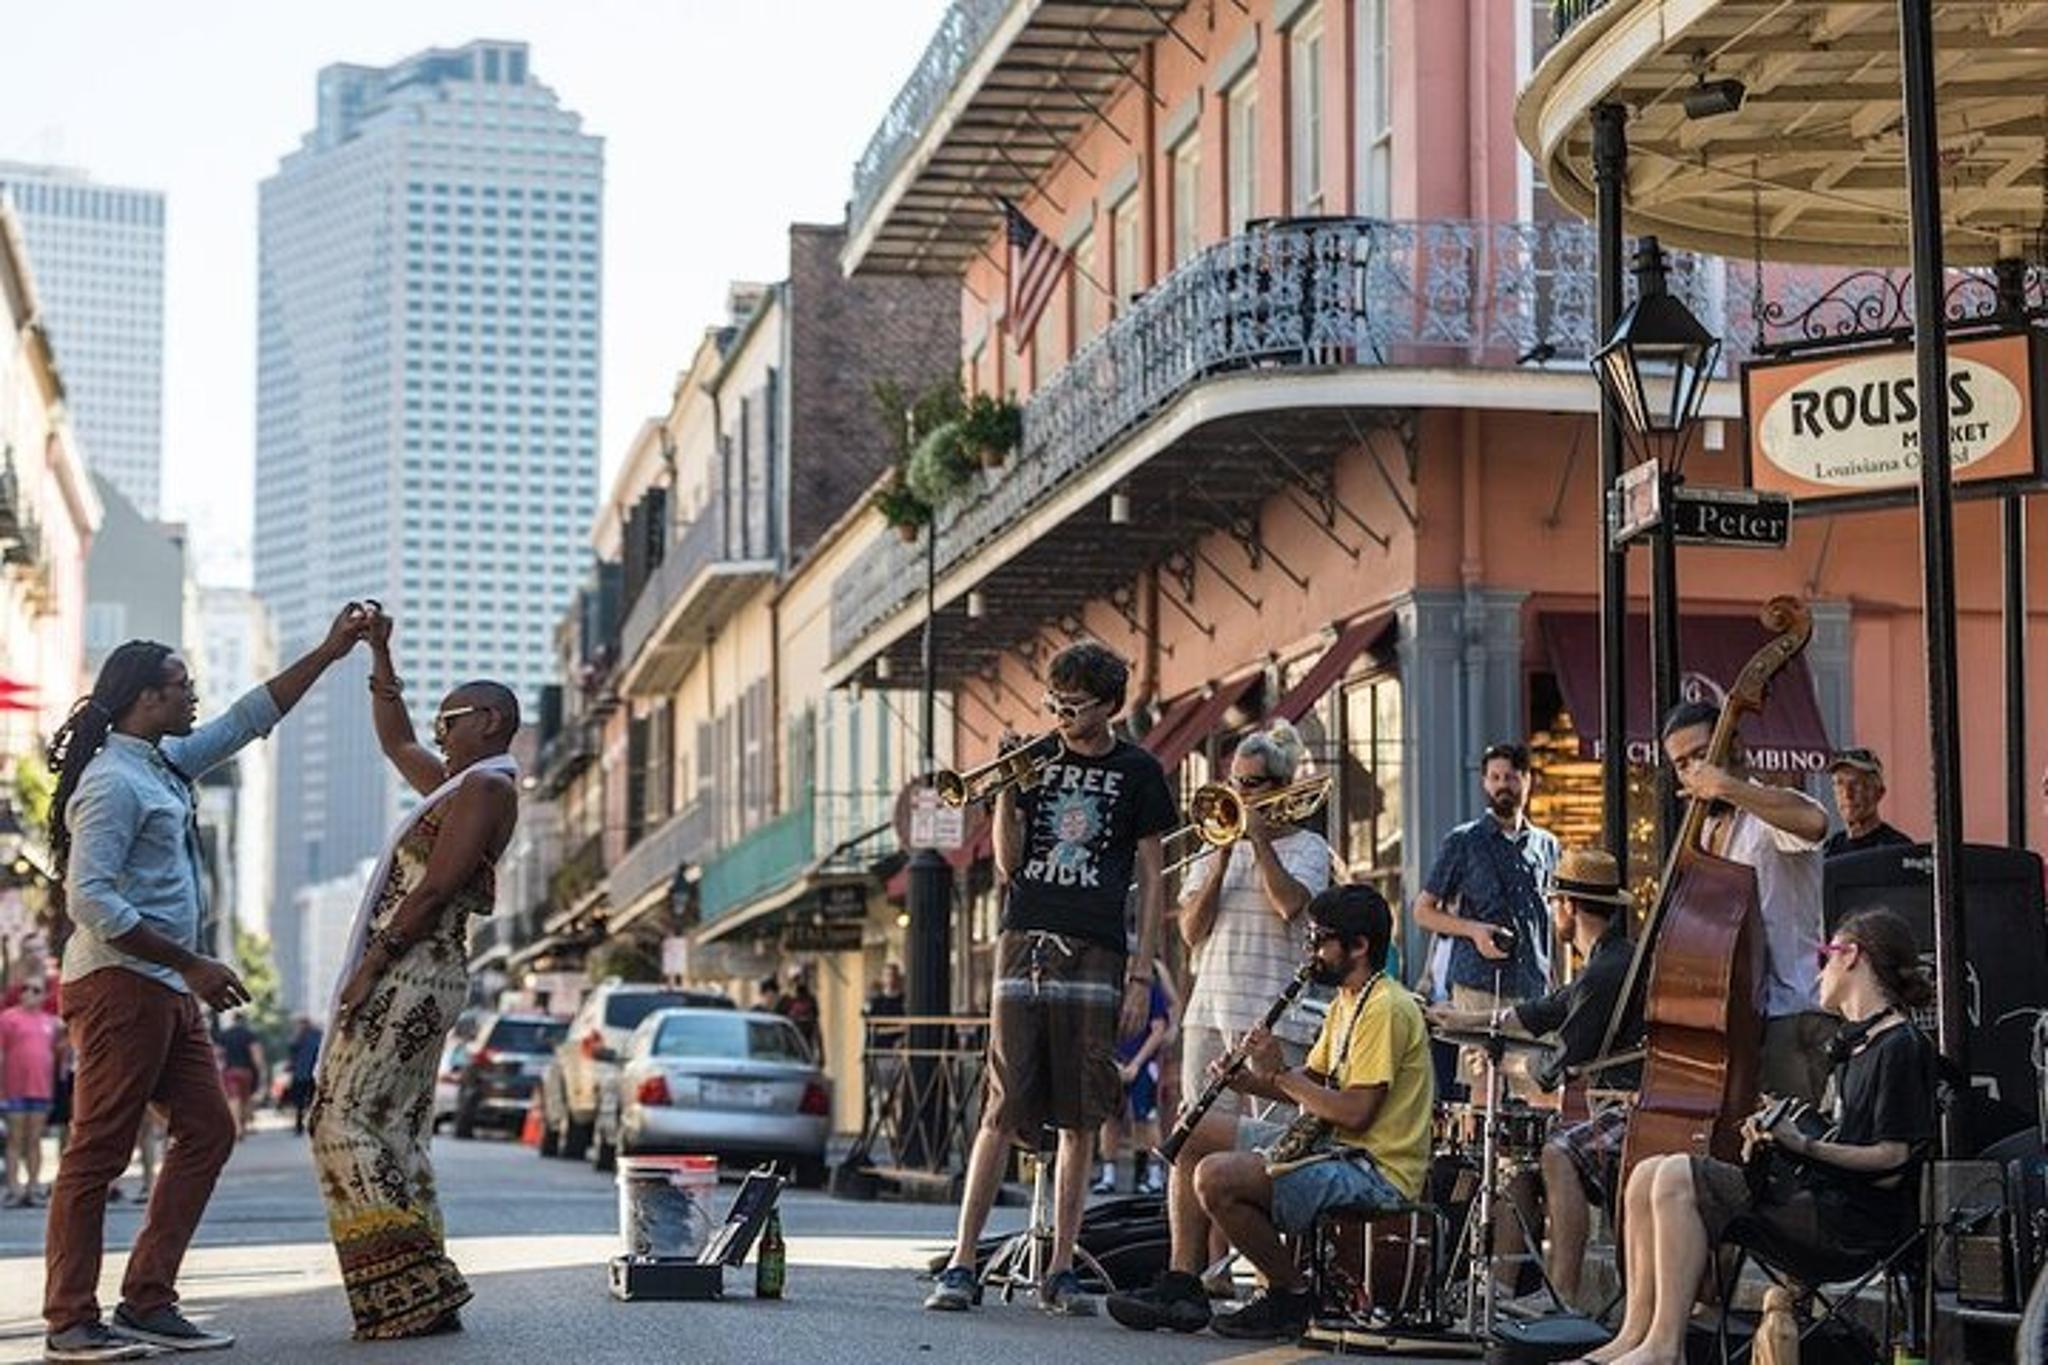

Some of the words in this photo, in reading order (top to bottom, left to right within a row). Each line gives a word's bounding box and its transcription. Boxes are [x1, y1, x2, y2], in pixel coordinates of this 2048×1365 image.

[1791, 371, 1974, 439] ROUSS
[1902, 422, 1990, 448] MKET
[1815, 456, 1899, 479] Louisiana
[1698, 505, 1785, 538] Peter
[1043, 764, 1123, 796] FREE
[1023, 858, 1100, 887] RICK
